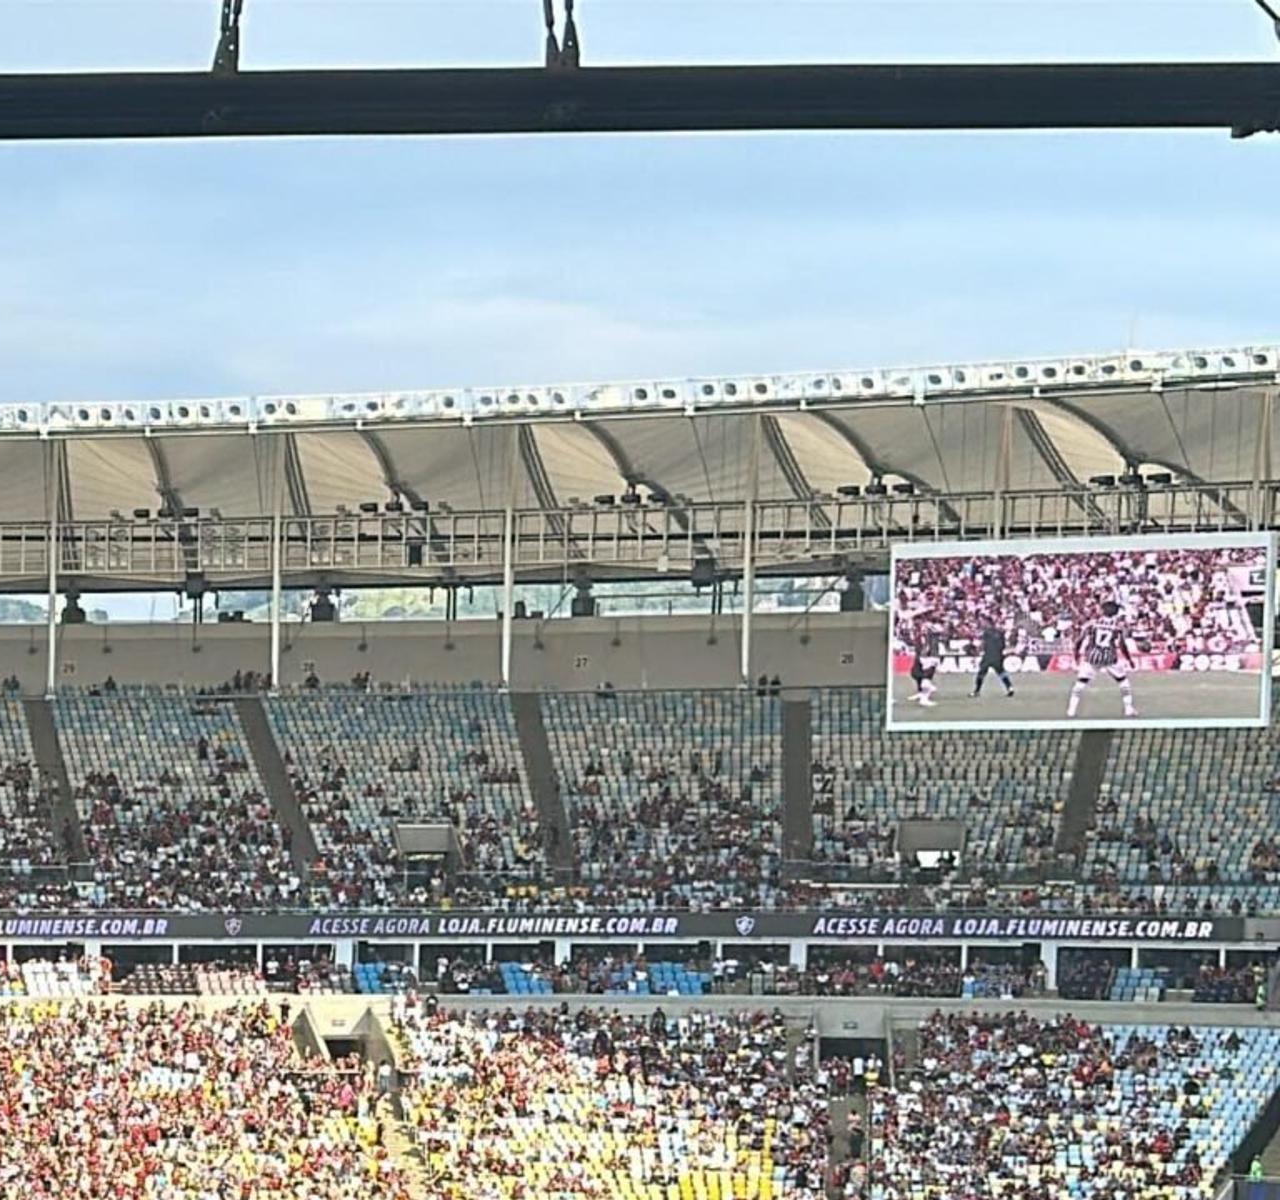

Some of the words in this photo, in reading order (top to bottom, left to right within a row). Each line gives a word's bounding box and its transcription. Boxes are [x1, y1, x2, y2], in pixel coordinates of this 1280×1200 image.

[309, 918, 370, 934] ACESSE
[373, 918, 430, 934] AGORA
[437, 918, 679, 934] LOJA.FLUMINENSE.COM.BR
[813, 918, 879, 935] ACESSE
[882, 918, 945, 936] AGORA
[952, 919, 1214, 937] LOJA.FLUMINENSE.COM.BR
